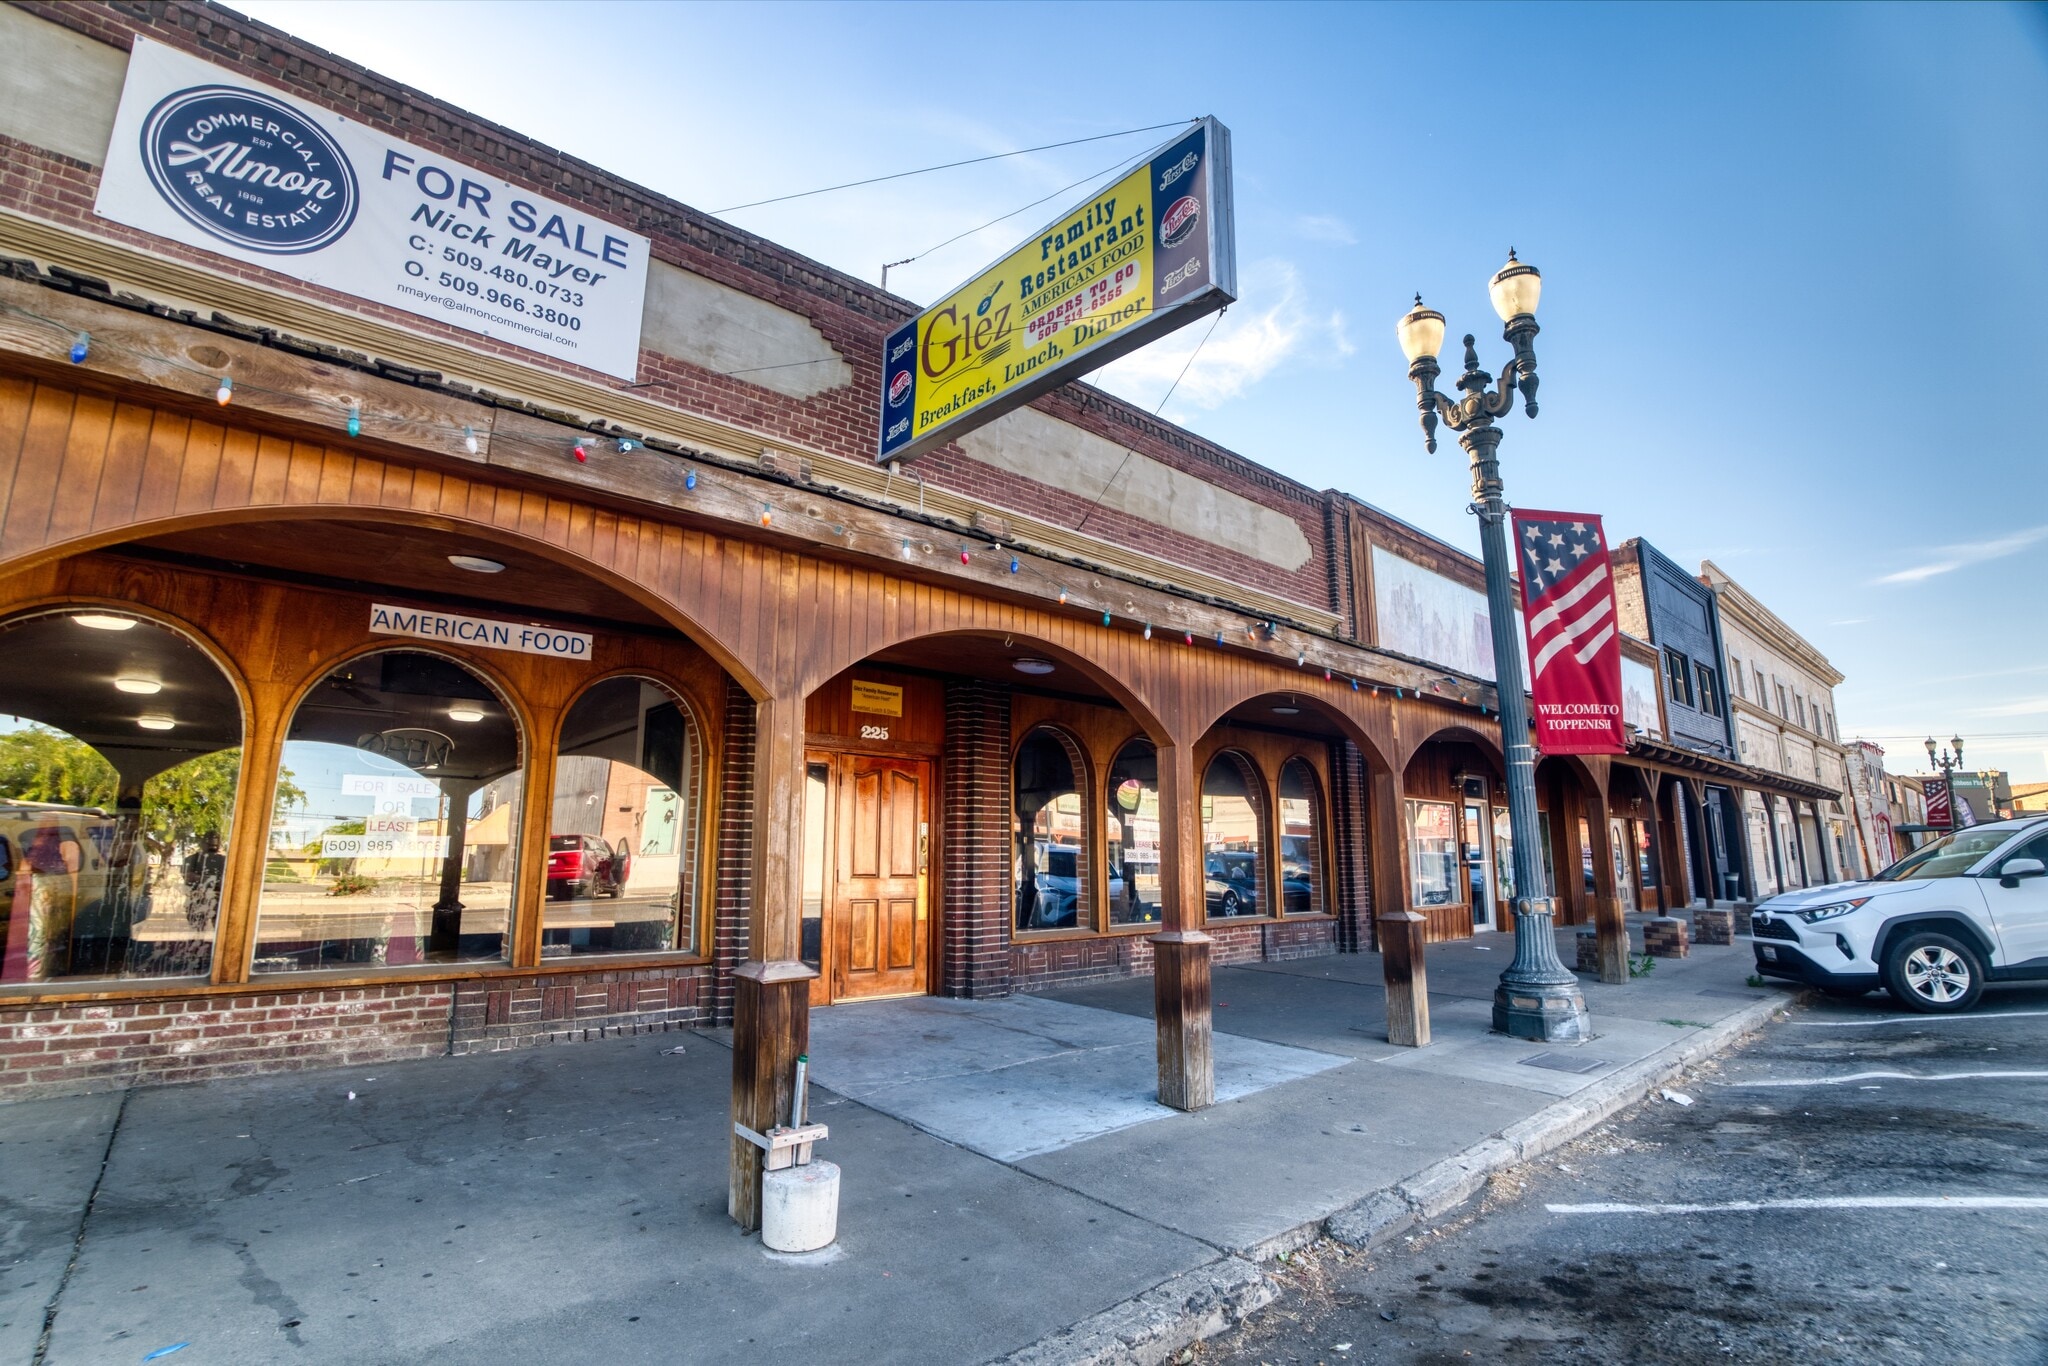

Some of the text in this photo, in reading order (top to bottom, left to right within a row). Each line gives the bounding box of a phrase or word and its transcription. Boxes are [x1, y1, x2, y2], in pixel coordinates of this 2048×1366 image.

[168, 141, 336, 200] Almon
[187, 113, 321, 172] COMMERCIAL
[252, 136, 273, 149] EST
[185, 170, 322, 228] REAL ESTATE
[381, 149, 629, 270] FOR SALE
[410, 203, 607, 287] Nick Mayer
[1020, 204, 1144, 299] Restaurant
[1041, 198, 1116, 261] Family
[404, 260, 581, 332] O. 509.966.3800
[409, 235, 584, 308] C: 509.480.0733
[1022, 234, 1144, 317] AMERICAN FOOD
[1029, 263, 1133, 333] ORDERS TO GO
[397, 283, 578, 349] nmayer@almoncommercial.com
[921, 303, 1012, 378] Glez
[1038, 323, 1058, 341] 509
[919, 297, 1146, 429] Breakfast, Lunch, Dinner
[373, 609, 585, 655] AMERICAN FOOD
[861, 725, 889, 740] 225
[1538, 704, 1619, 715] WELCOME TO
[1547, 719, 1612, 730] TOPPENISH
[354, 781, 431, 794] FOR SALE
[382, 801, 405, 813] OR
[324, 840, 361, 854] (509)
[367, 840, 393, 851] 985
[369, 821, 414, 833] LEASE
